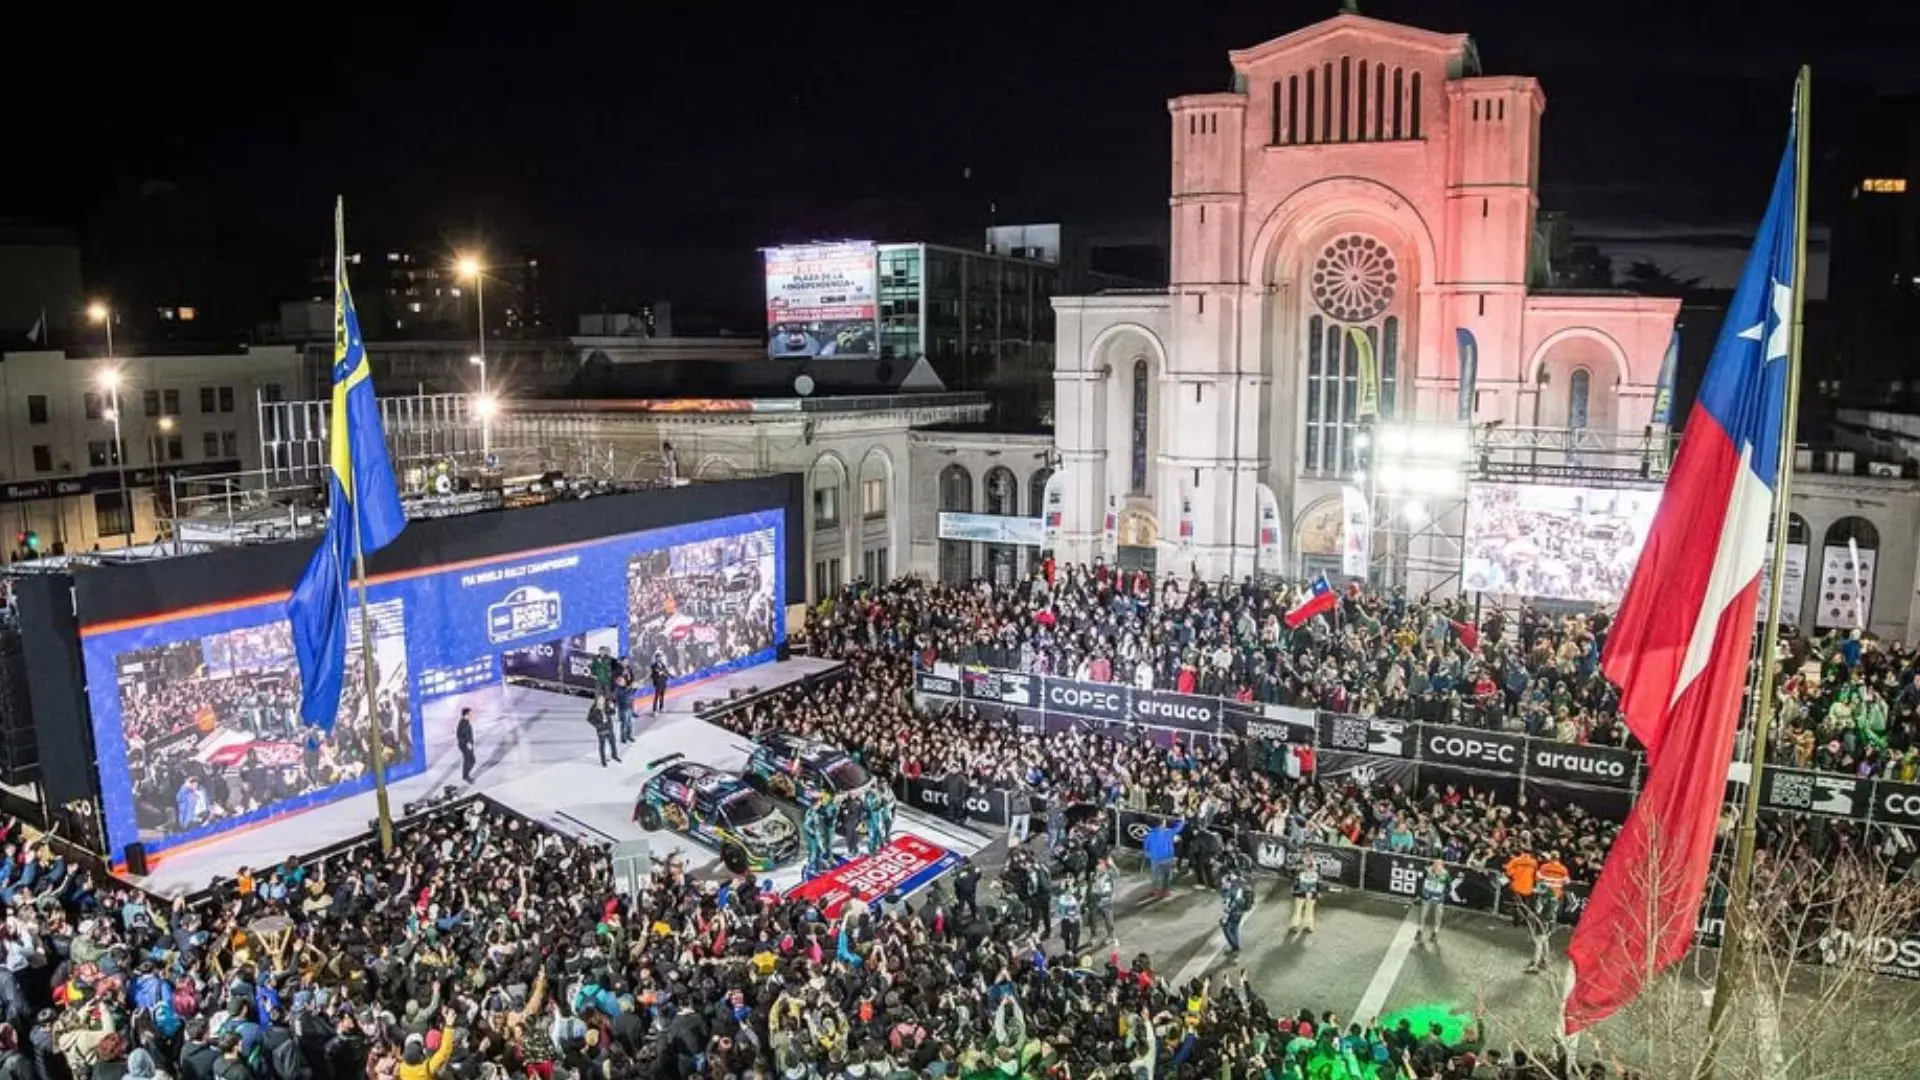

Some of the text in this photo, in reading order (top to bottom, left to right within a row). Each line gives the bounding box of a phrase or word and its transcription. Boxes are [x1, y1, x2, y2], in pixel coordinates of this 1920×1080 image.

[1050, 686, 1120, 711] COPEC
[1138, 699, 1211, 722] arauco
[1430, 735, 1515, 764] COPEC
[1536, 749, 1625, 777] arauco
[921, 788, 991, 813] arco
